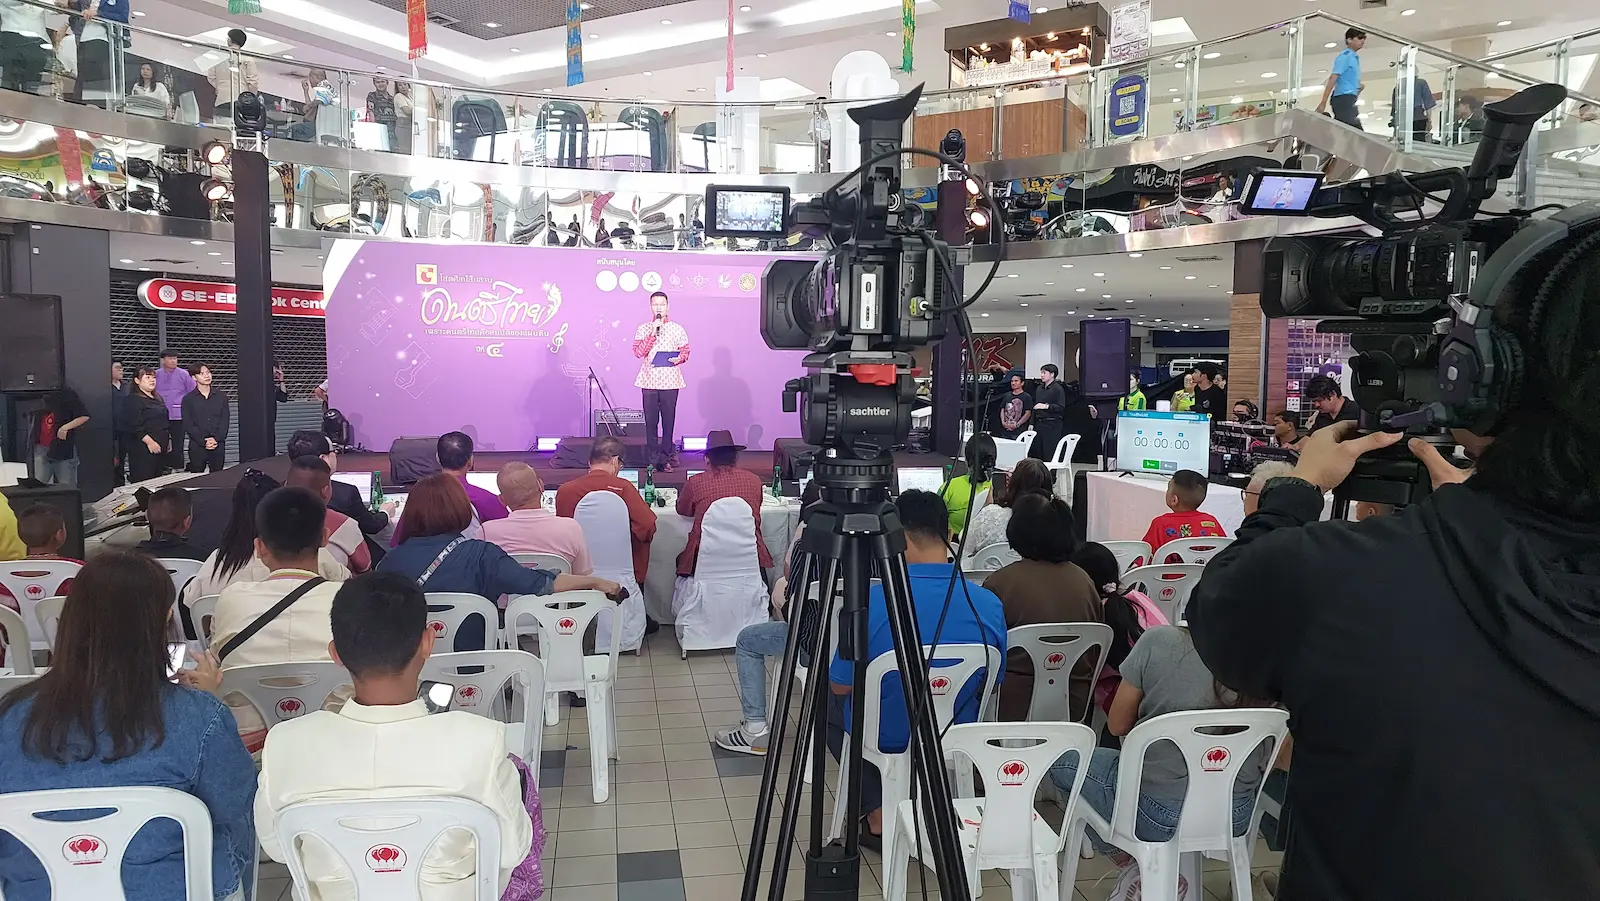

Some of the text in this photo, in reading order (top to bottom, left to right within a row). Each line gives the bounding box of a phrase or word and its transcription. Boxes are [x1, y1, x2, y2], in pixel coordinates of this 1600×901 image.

[596, 257, 636, 268] สนับสนุนโดย
[421, 281, 556, 328] ดนตรีไทย
[850, 406, 890, 416] sachtler
